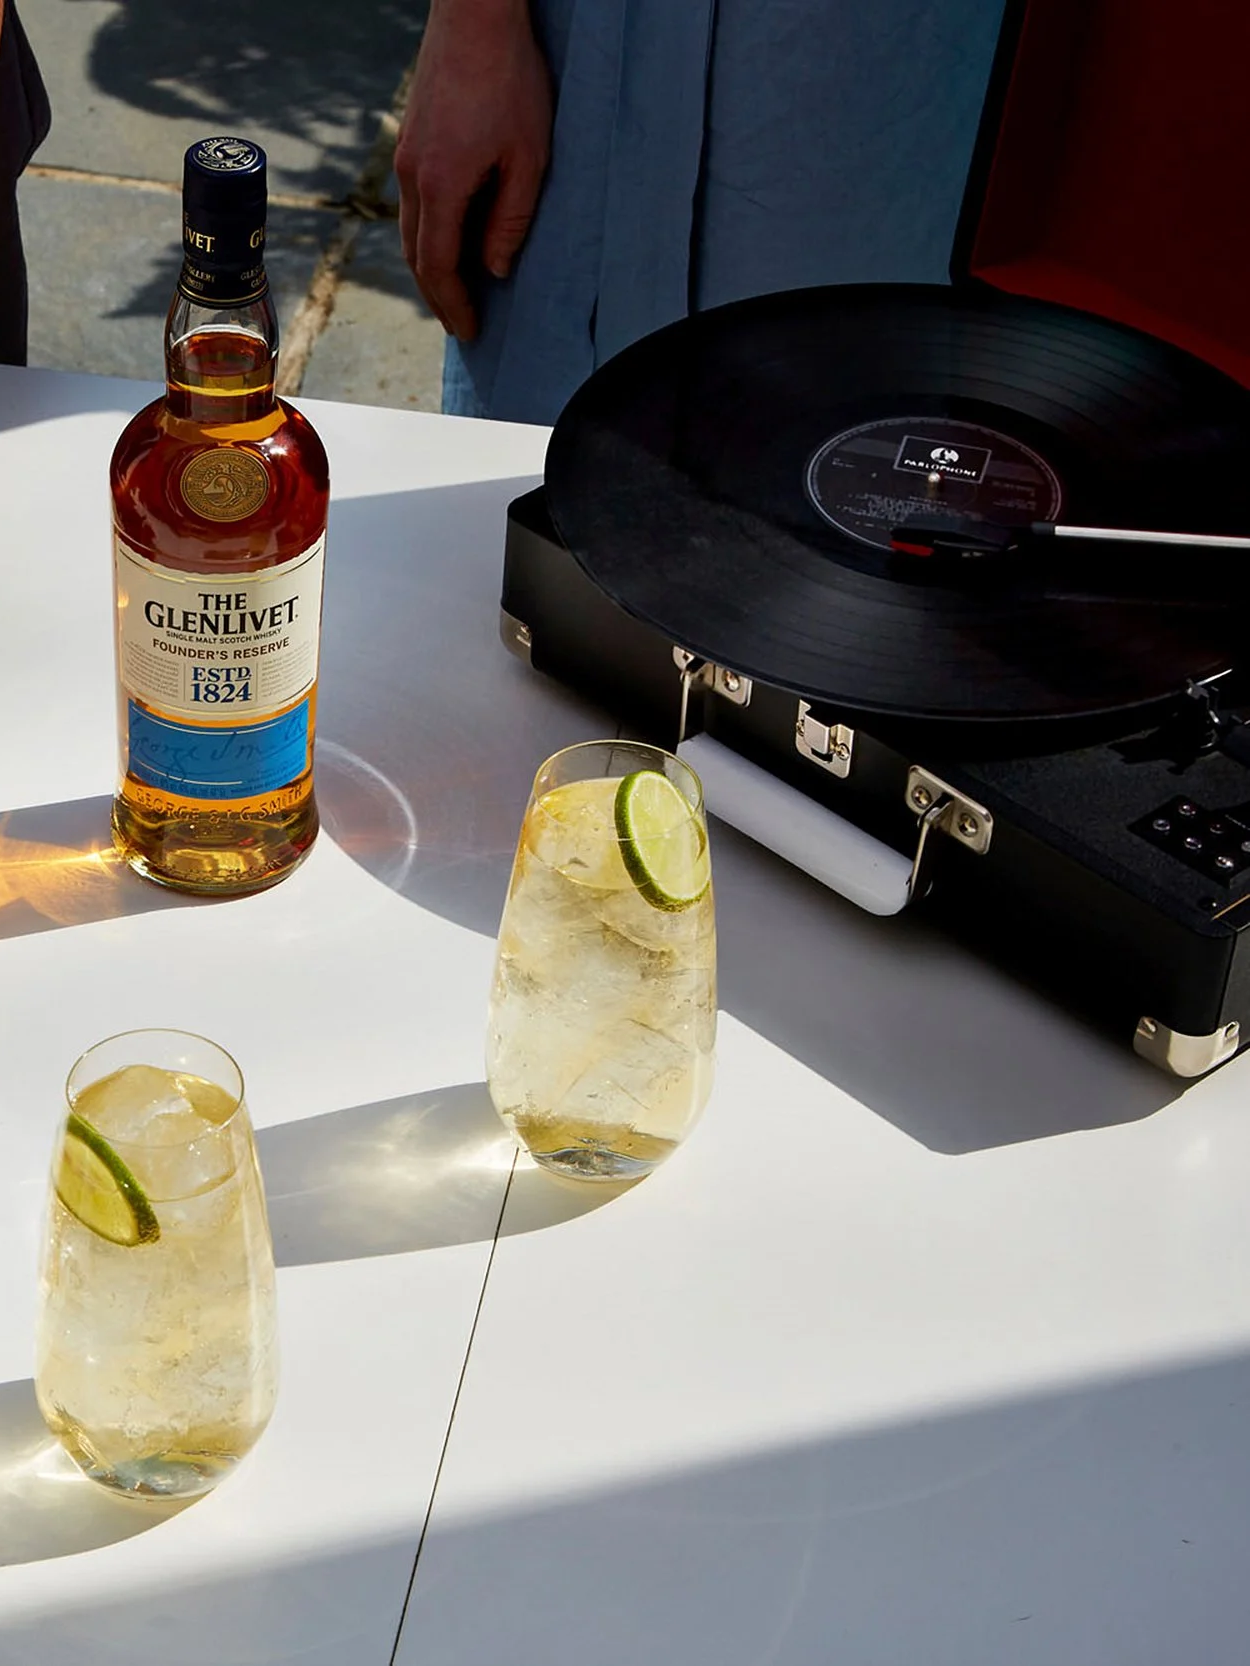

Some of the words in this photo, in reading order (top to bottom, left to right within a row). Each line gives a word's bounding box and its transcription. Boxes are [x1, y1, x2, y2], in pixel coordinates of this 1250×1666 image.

[904, 459, 977, 477] PARLOPHONE
[198, 592, 247, 611] THE
[166, 630, 194, 643] SINGLE
[195, 636, 217, 645] MALT
[219, 636, 252, 645] SCOTCH
[253, 628, 282, 641] WHISKY
[152, 638, 228, 660] FOUNDER'S
[233, 637, 290, 660] RESERVE
[190, 682, 252, 703] 1824
[136, 787, 200, 823] GEORGE
[258, 785, 302, 819] SMITH
